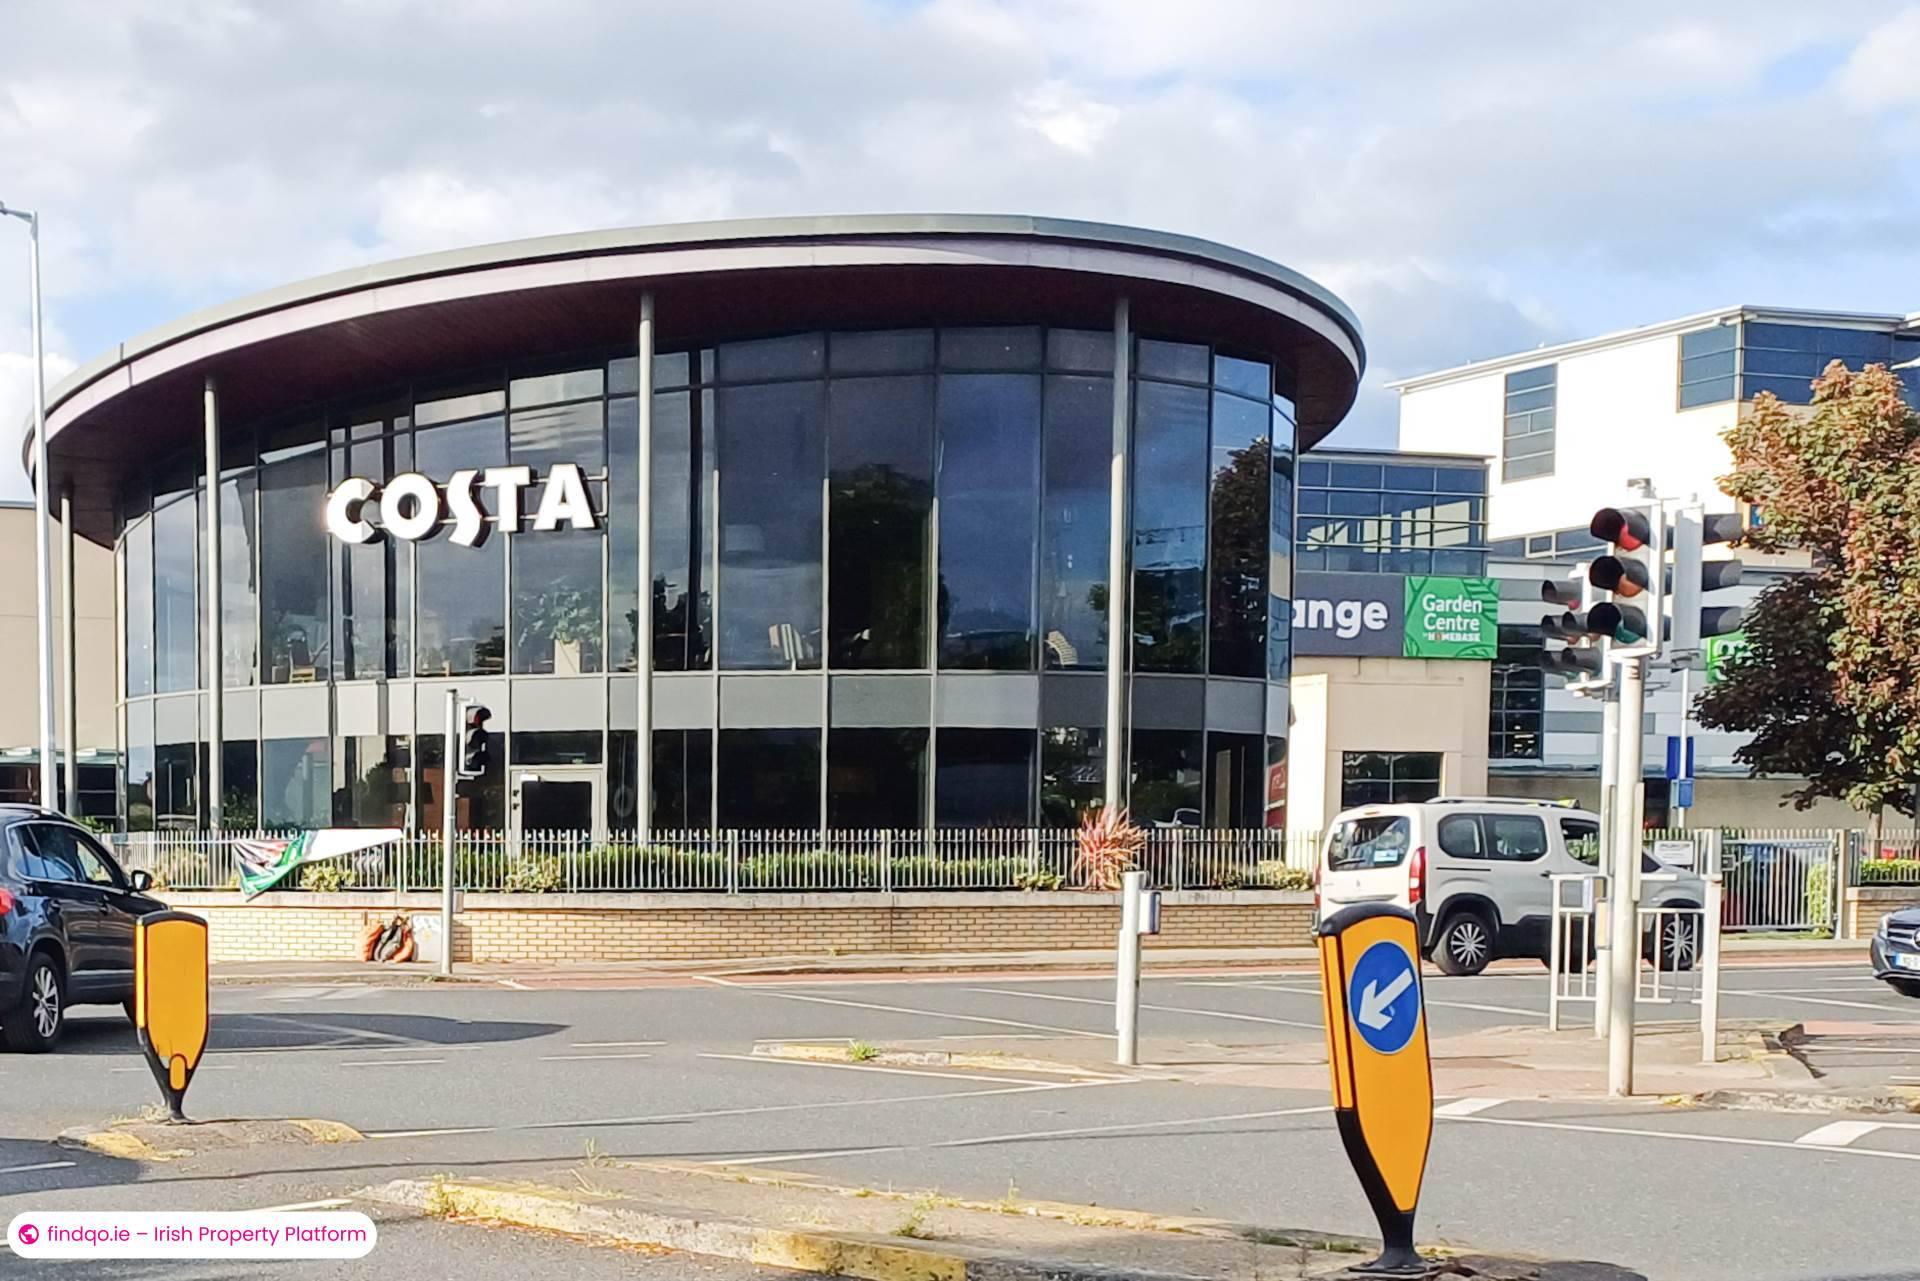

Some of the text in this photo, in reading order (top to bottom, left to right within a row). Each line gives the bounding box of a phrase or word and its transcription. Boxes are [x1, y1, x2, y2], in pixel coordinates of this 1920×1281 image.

[326, 463, 597, 547] COSTA
[1422, 593, 1483, 614] Garden
[1423, 612, 1480, 632] Centre
